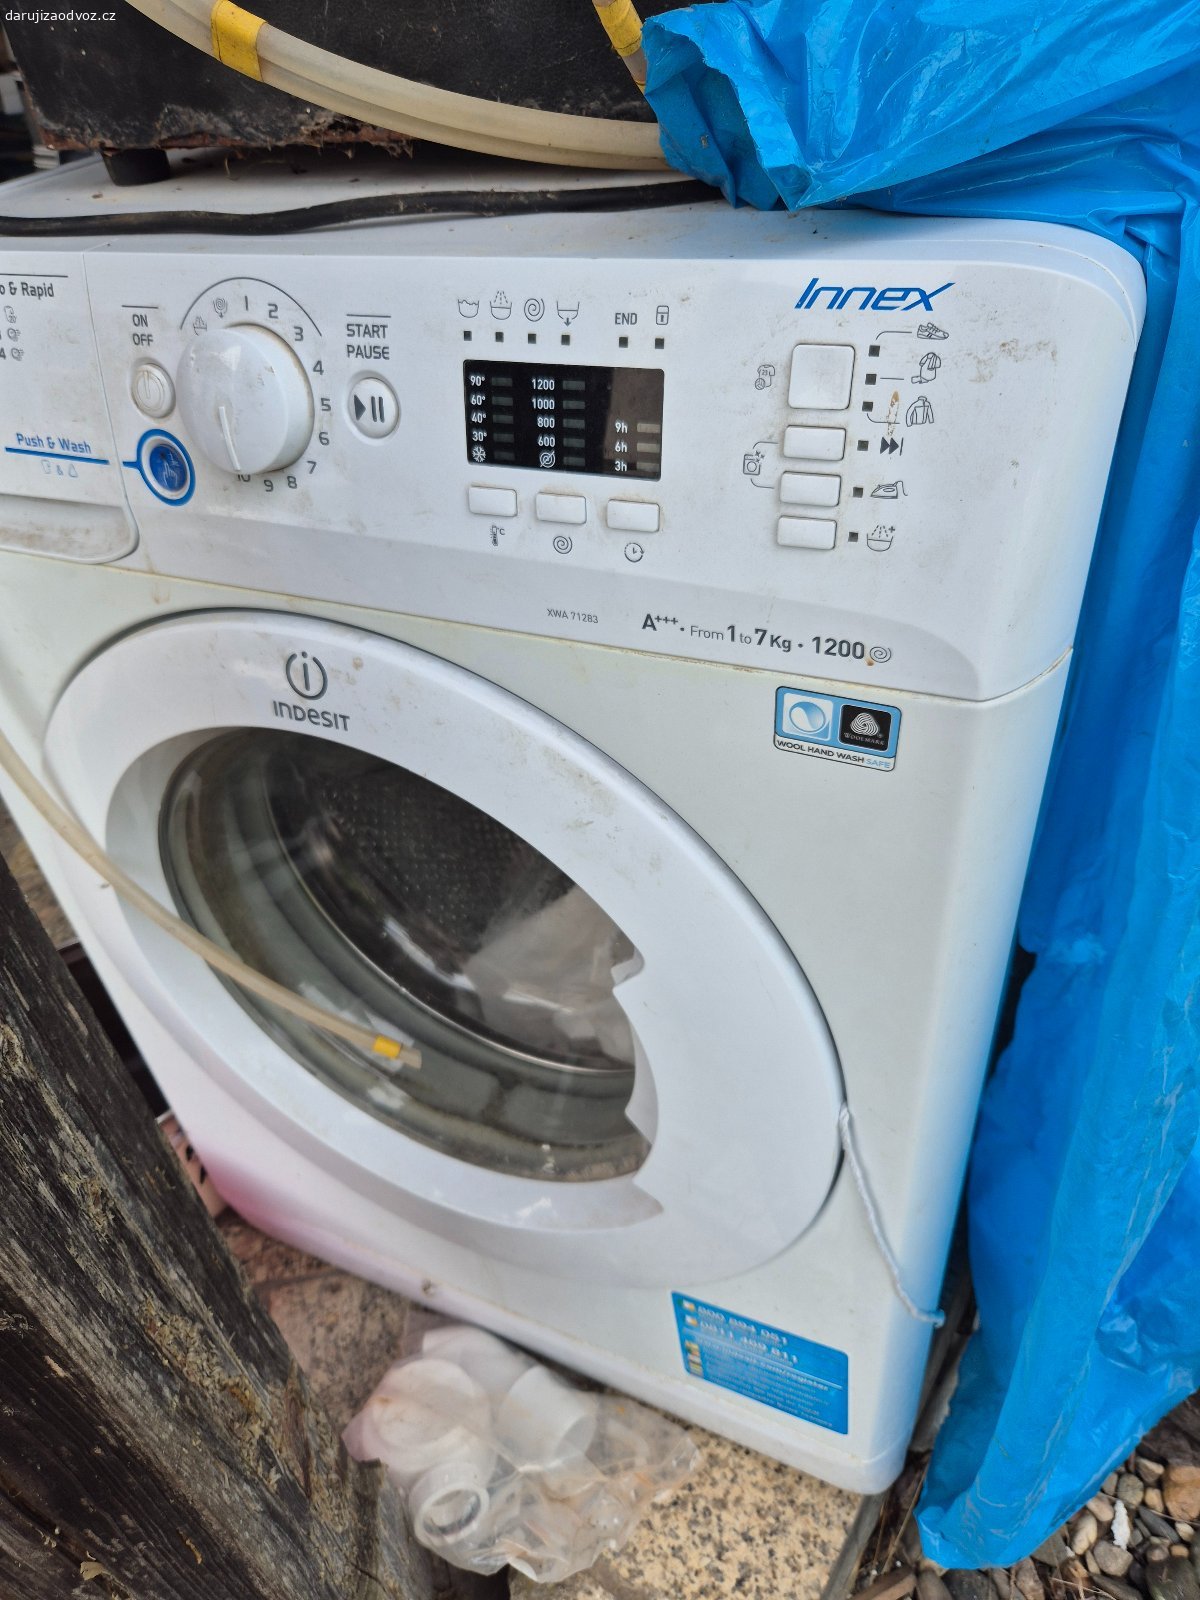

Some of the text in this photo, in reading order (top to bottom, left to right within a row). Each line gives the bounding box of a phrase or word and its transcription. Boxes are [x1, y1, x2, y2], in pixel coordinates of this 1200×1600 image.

[9, 281, 18, 295] &
[21, 282, 54, 300] Rapid
[794, 277, 956, 311] Innex
[244, 295, 249, 311] 1
[267, 303, 279, 318] 2
[132, 313, 149, 327] ON
[615, 312, 638, 326] END
[293, 326, 305, 342] 3
[346, 323, 389, 339] START
[132, 333, 154, 346] OFF
[346, 344, 390, 360] PAUSE
[312, 360, 325, 375] 4
[531, 378, 556, 391] 1200
[320, 397, 332, 412] 5
[531, 398, 556, 410] 1000
[536, 417, 556, 429] 800
[614, 422, 628, 434] 9h
[16, 432, 92, 454] Push & Wash
[318, 431, 330, 446] 6
[537, 436, 556, 448] 600
[614, 441, 628, 453] 6h
[306, 460, 317, 475] 7
[614, 461, 628, 472] 3h
[263, 479, 274, 492] 9
[286, 475, 298, 489] 8
[546, 608, 599, 624] XWA 71283
[690, 625, 724, 641] From
[739, 632, 752, 645] to
[811, 636, 865, 660] 1200
[776, 740, 891, 769] WOOL HAND WASH SAFE
